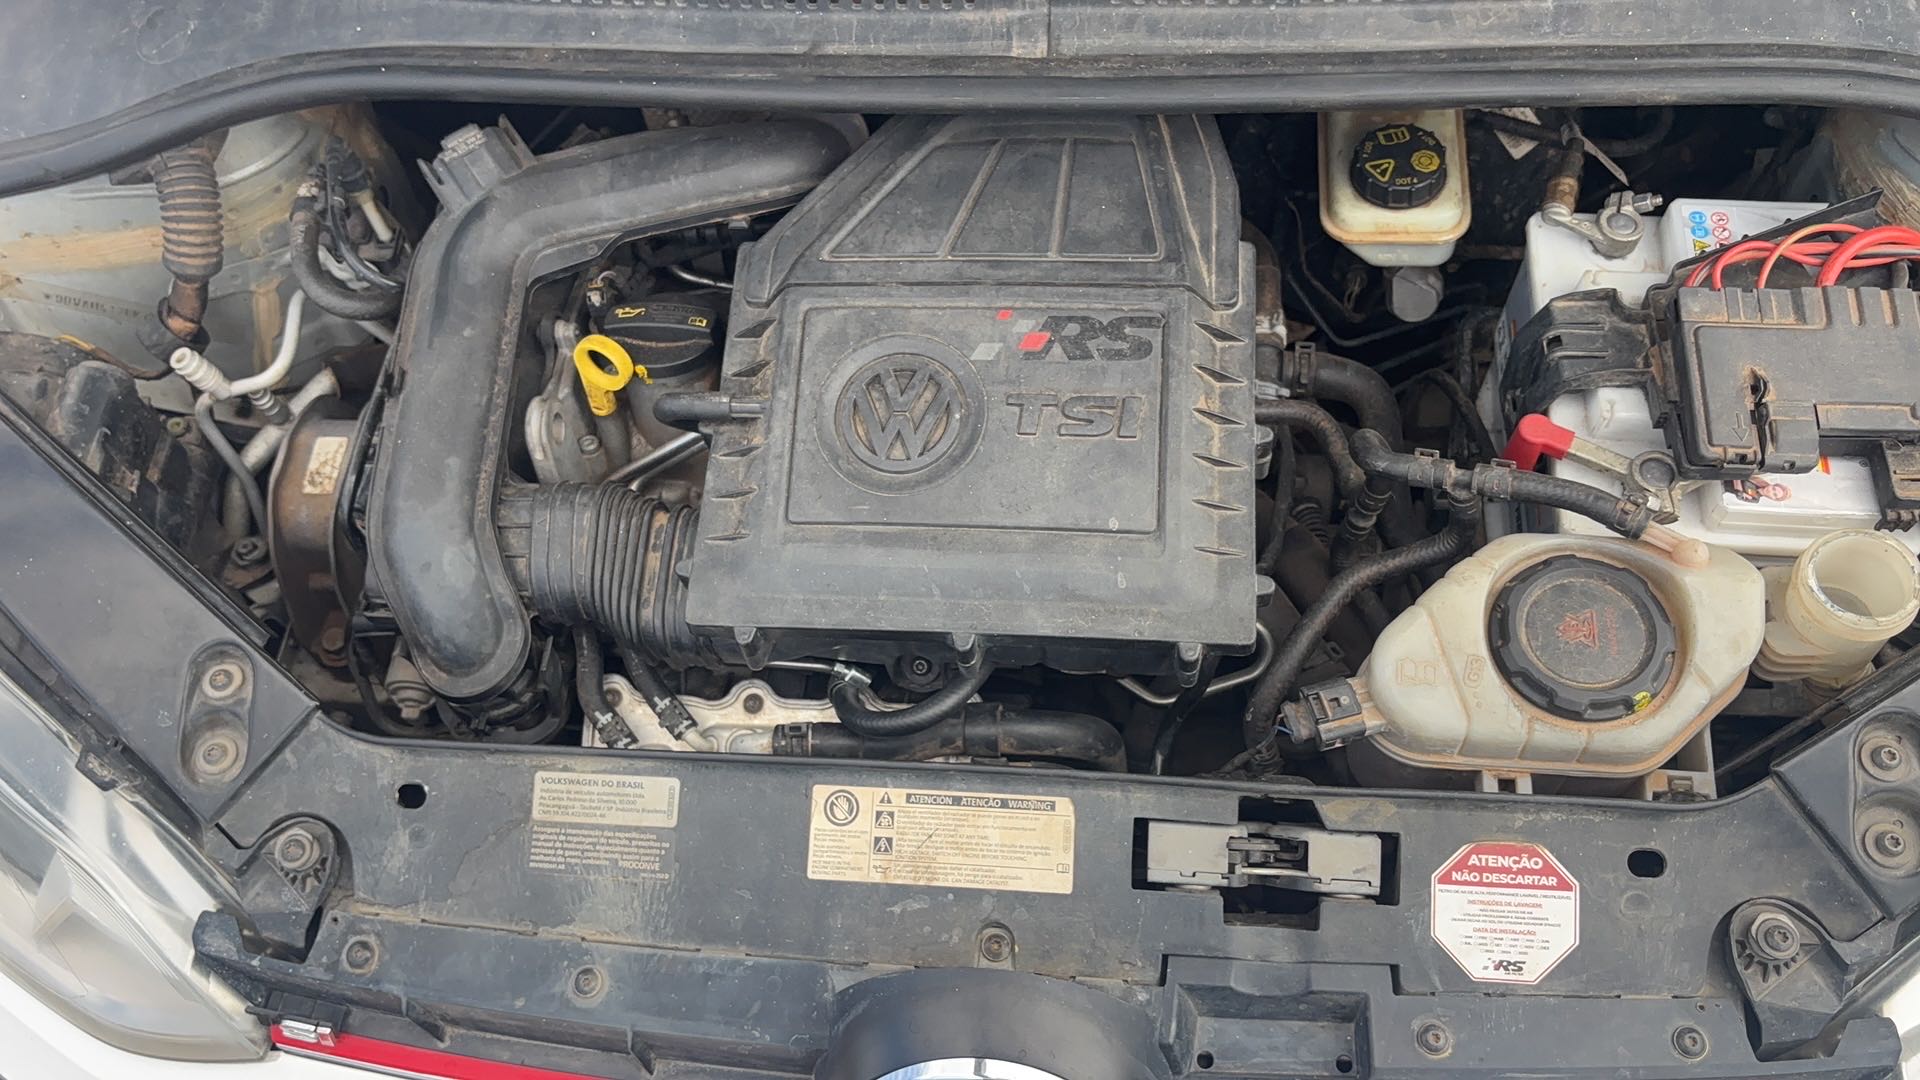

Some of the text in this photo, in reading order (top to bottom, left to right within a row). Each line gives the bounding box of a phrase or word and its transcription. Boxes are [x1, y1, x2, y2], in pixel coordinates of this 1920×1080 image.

[1395, 177, 1411, 185] DOT
[1018, 315, 1164, 361] RS
[1005, 391, 1143, 439] TSI
[540, 777, 644, 788] VOLKSWAGEN DO BRASIL
[909, 795, 1051, 810] ATENCIÓN ATENÇÃO WARNING
[618, 860, 660, 869] PROCONVE
[1467, 853, 1543, 871] ATENÇÃO
[1452, 870, 1558, 887] NÃO DESCARTAR
[1466, 898, 1503, 906] INSTRUÇÕES
[1493, 958, 1526, 972] RS
